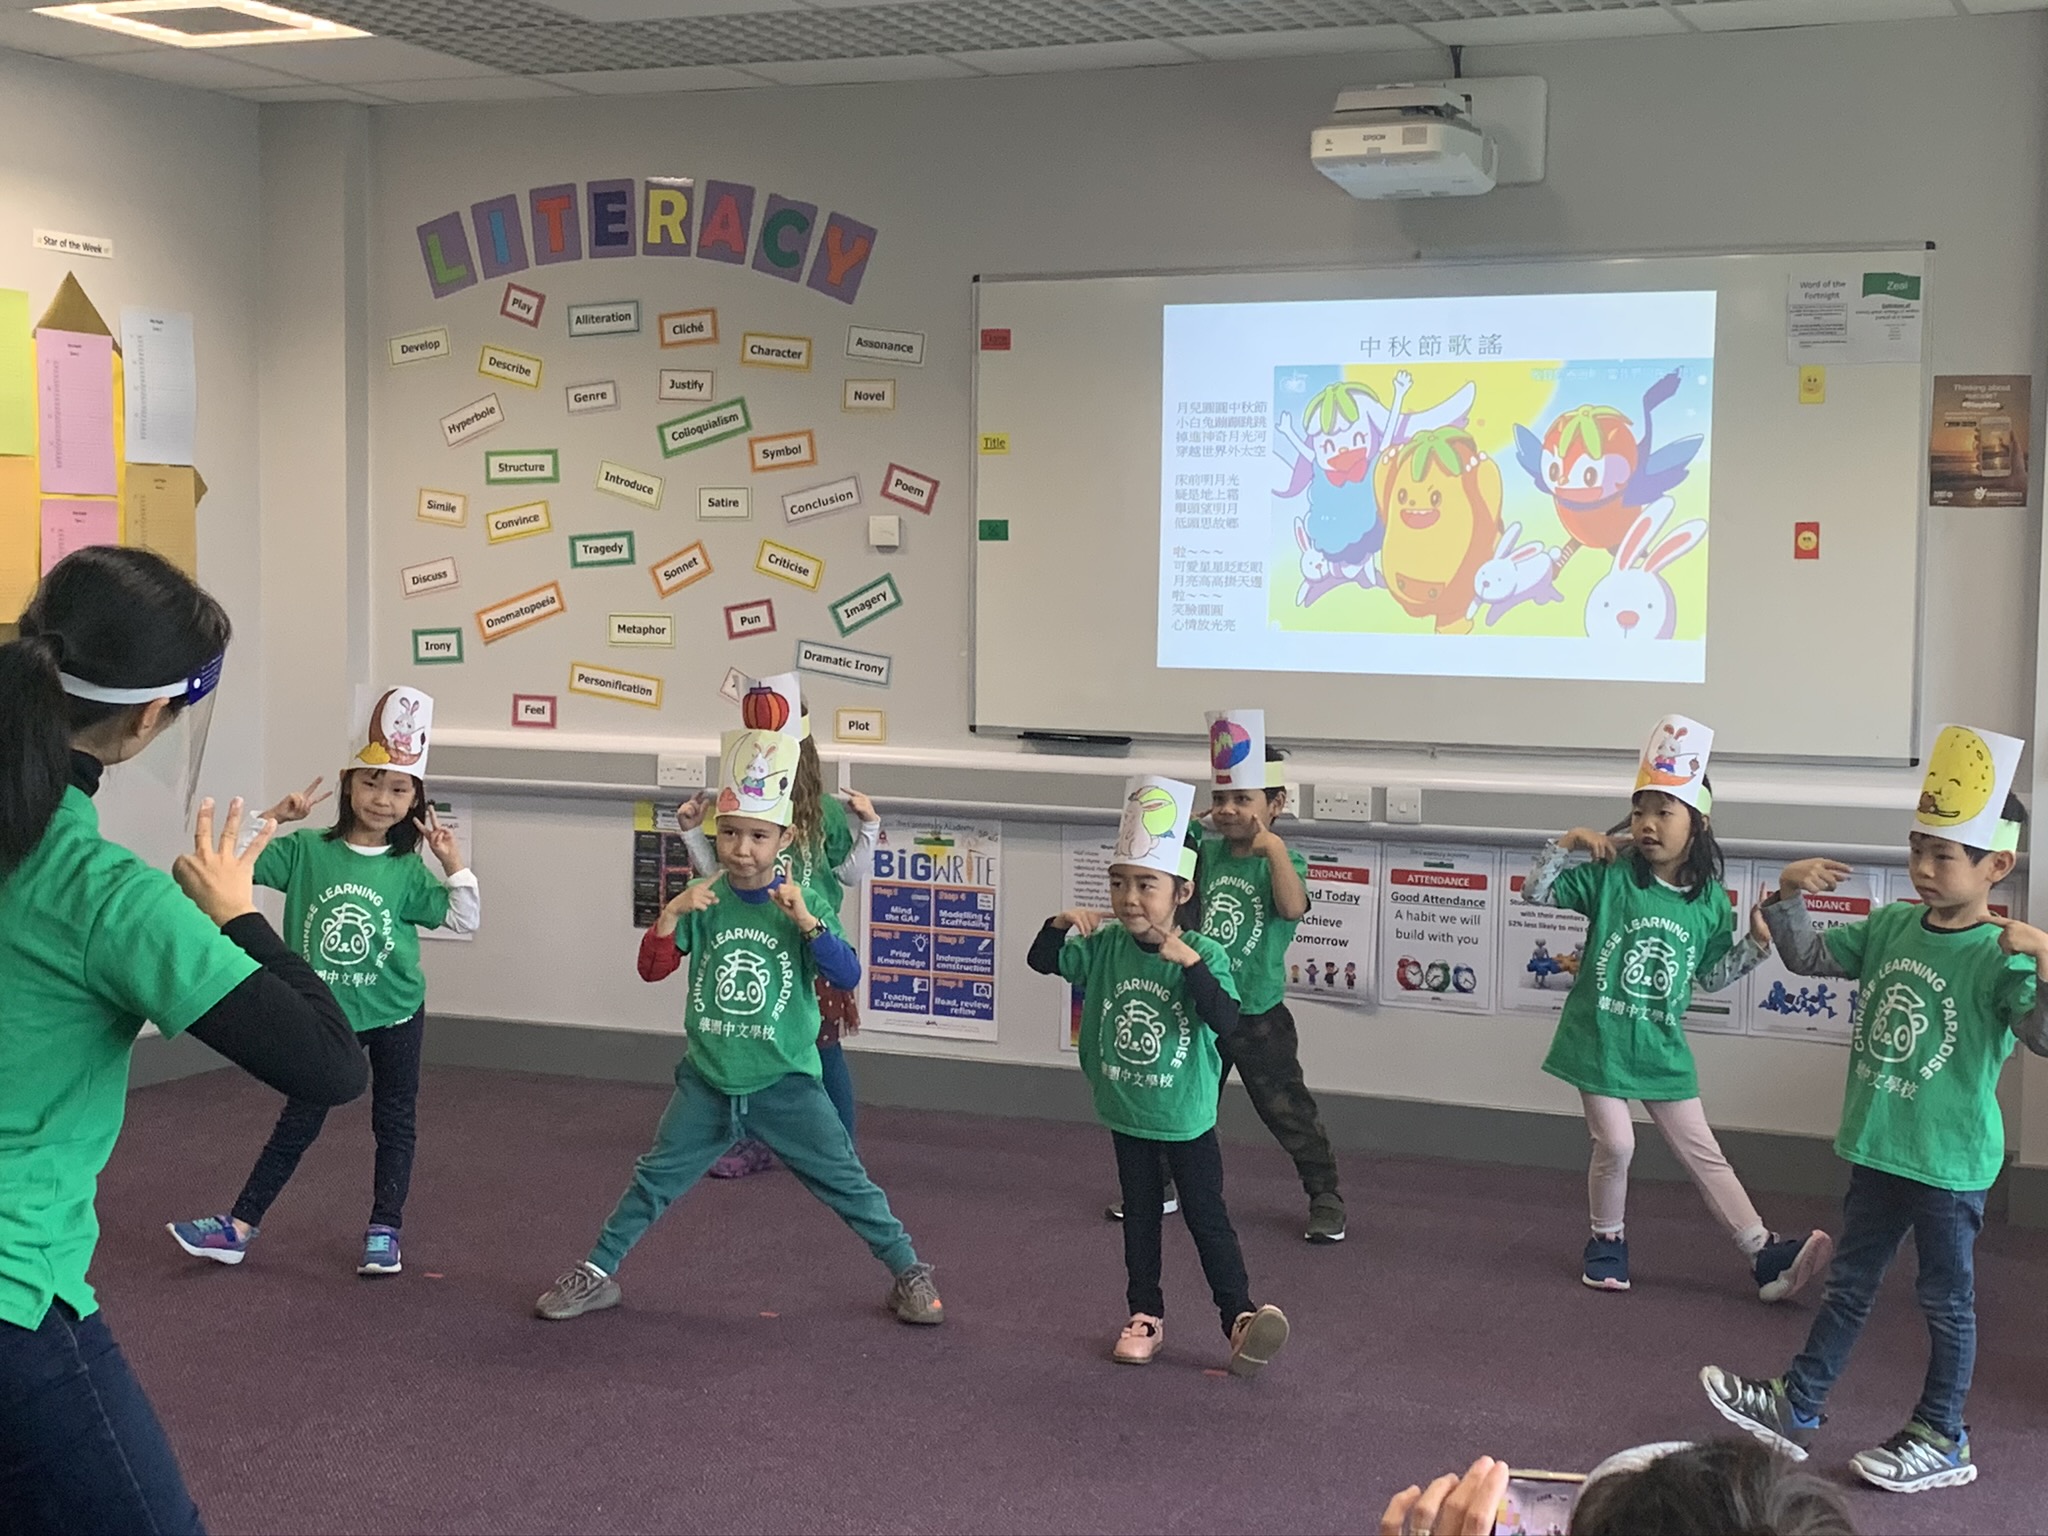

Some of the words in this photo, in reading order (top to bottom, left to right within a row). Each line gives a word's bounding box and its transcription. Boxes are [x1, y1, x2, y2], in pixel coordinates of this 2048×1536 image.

[43, 235, 58, 247] Star
[59, 237, 68, 247] of
[68, 239, 81, 249] the
[82, 241, 103, 254] Week
[427, 189, 869, 286] LITERACY
[1800, 279, 1821, 290] Word
[1822, 279, 1831, 288] of
[1832, 279, 1846, 288] the
[1804, 291, 1840, 301] Fortnight
[511, 297, 533, 315] Play
[575, 310, 632, 326] Alliteration
[672, 320, 705, 335] Cliché
[400, 337, 441, 356] Develop
[750, 344, 803, 361] Character
[855, 336, 914, 354] Assonance
[1359, 334, 1504, 358] 中秋節歌謠
[488, 356, 532, 378] Describe
[668, 378, 705, 393] Justify
[573, 389, 608, 404] Genre
[854, 389, 886, 402] Novel
[447, 405, 497, 436] Hyperbole
[671, 411, 740, 443] Colloquialism
[983, 437, 1006, 450] Title
[761, 444, 803, 461] Symbol
[498, 460, 545, 474] Structure
[604, 471, 655, 497] Introduce
[894, 478, 925, 499] Poem
[426, 499, 457, 514] Simile
[707, 496, 739, 509] Satire
[789, 488, 854, 516] Conclusion
[494, 512, 541, 531] Convince
[582, 542, 624, 559] Tragedy
[663, 556, 699, 582] Sonnet
[767, 553, 810, 578] Criticise
[411, 569, 448, 586] Discuss
[485, 594, 557, 631] Onomatopoeia
[844, 589, 888, 620] Imagery
[740, 613, 761, 627] Pun
[616, 622, 667, 637] Metaphor
[424, 640, 452, 654] Irony
[803, 649, 850, 668] Dramatic
[851, 658, 885, 676] Irony
[577, 673, 653, 696] Personification
[524, 703, 546, 716] Feel
[847, 719, 871, 732] Plot
[1306, 867, 1353, 881] TENDANCE
[1407, 874, 1470, 887] ATTENDANCE
[318, 883, 384, 907] LEARNING
[1324, 890, 1361, 905] Today
[1390, 891, 1420, 903] Good
[1422, 894, 1486, 908] Attendance
[890, 905, 913, 914] Mind
[1806, 899, 1852, 912] NDANCE
[884, 913, 900, 921] the
[901, 915, 920, 923] GAP
[939, 909, 983, 921] Modelling
[1394, 909, 1404, 920] A
[1406, 910, 1437, 923] habit
[1438, 915, 1457, 925] we
[1459, 915, 1481, 926] will
[1395, 928, 1425, 941] build
[1427, 932, 1454, 943] with
[1456, 936, 1479, 946] you
[890, 949, 912, 958] Prior
[935, 953, 992, 965] Independent
[1595, 932, 1623, 992] CHINESE
[1624, 916, 1691, 944] LEARNING
[877, 956, 926, 969] Knowledge
[314, 969, 378, 988] 中文學校
[693, 951, 712, 1013] CHINESE
[711, 927, 779, 950] LEARNING
[777, 950, 794, 1022] PARADISE
[882, 992, 916, 1002] Teacher
[1114, 977, 1172, 1002] LEARNING
[874, 998, 927, 1011] Explanation
[950, 1007, 977, 1017] refine
[1854, 979, 1877, 1053] CHINESE
[1878, 957, 1947, 993] LEARNING
[1919, 996, 1959, 1081] PARADISE
